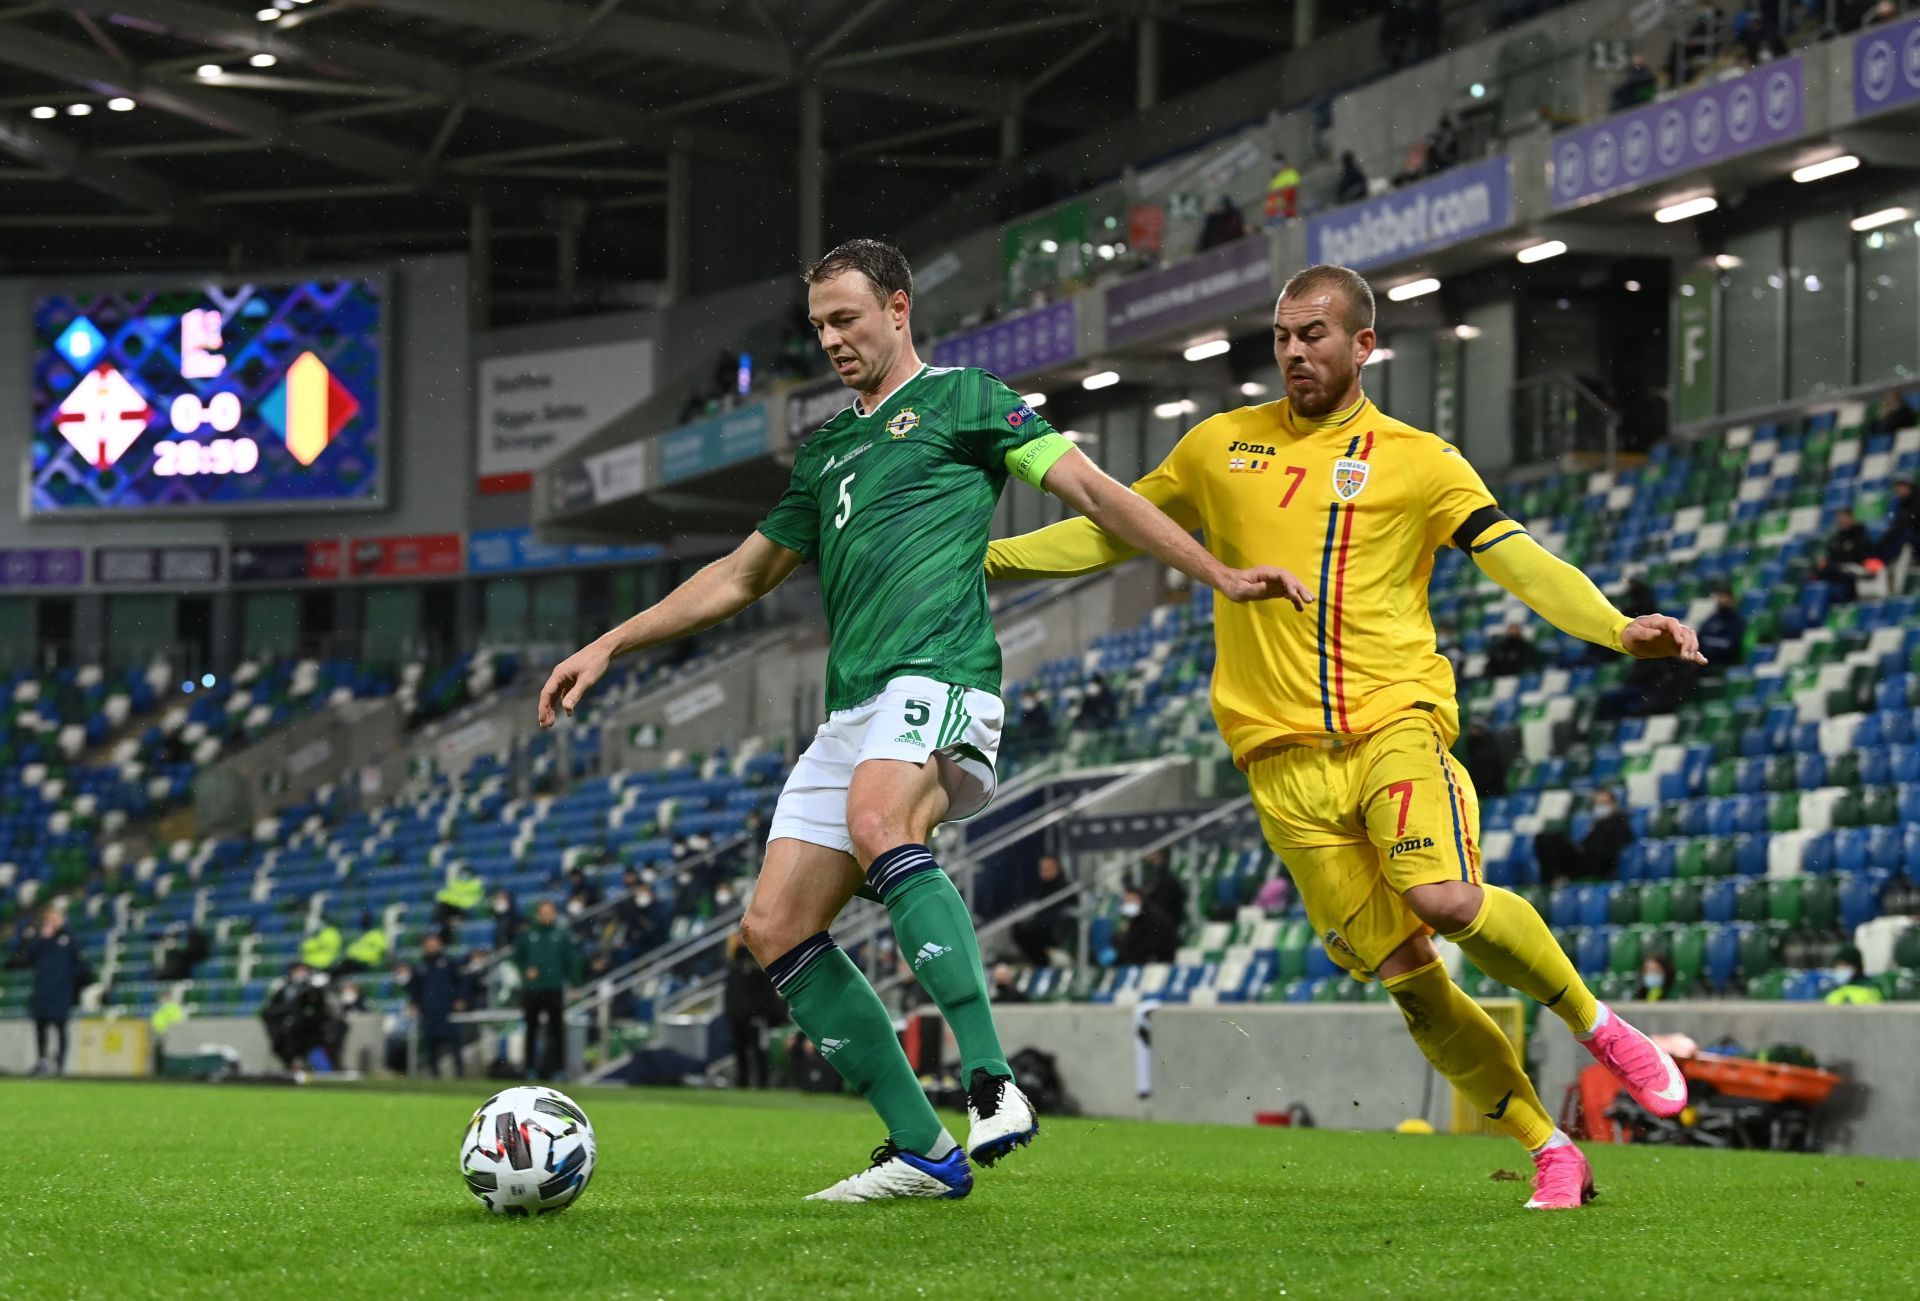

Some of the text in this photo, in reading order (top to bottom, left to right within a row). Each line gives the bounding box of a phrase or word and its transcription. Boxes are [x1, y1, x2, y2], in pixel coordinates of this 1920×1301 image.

[1020, 438, 1049, 470] RESPECT
[834, 472, 857, 529] 5
[1278, 466, 1307, 508] 7
[904, 698, 931, 727] 5
[893, 736, 926, 749] adidas
[1388, 782, 1413, 837] 7
